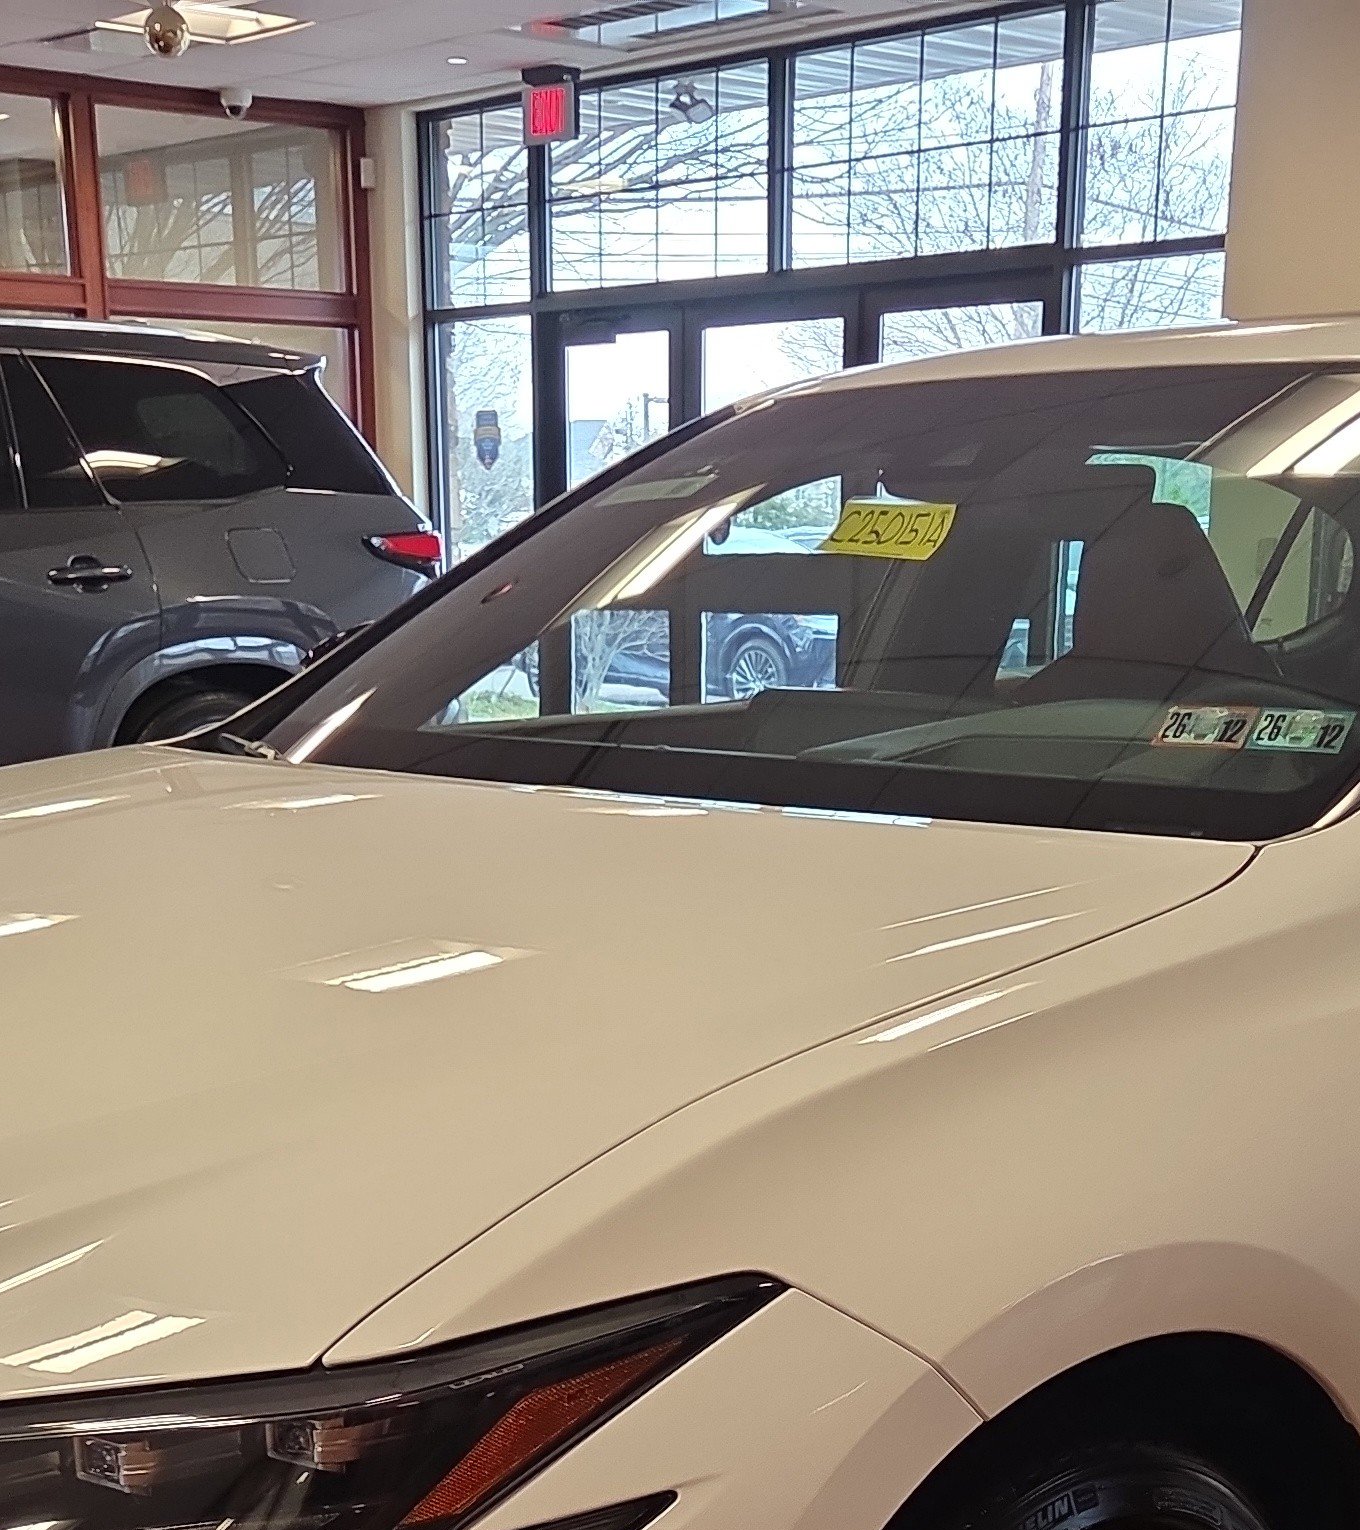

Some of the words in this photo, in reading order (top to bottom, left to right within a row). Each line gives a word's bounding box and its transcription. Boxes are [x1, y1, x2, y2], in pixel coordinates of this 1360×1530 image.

[1162, 711, 1192, 739] 26
[1217, 718, 1248, 743] 12
[1255, 713, 1287, 742] 26
[1315, 723, 1346, 749] 12
